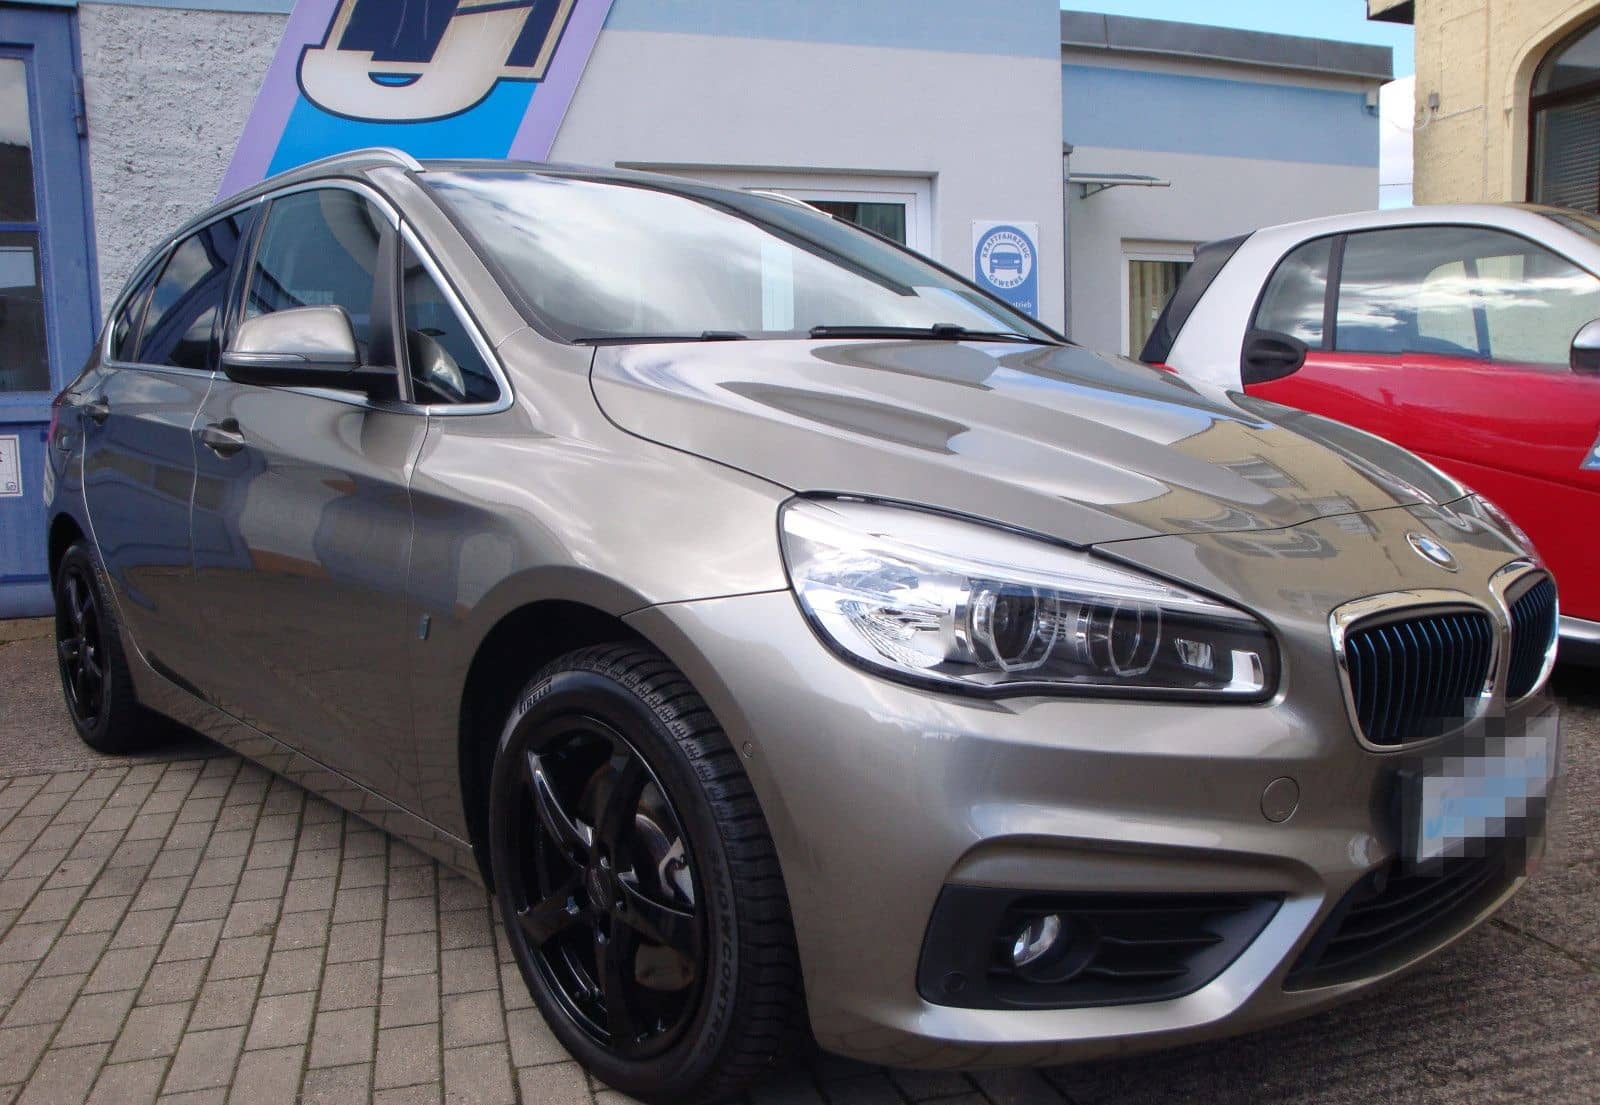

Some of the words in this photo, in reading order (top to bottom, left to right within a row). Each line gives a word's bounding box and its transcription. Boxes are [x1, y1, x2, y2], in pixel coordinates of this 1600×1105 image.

[982, 232, 1030, 259] KRAFTFAHRZEUG
[988, 274, 1023, 288] GEWERBE
[519, 678, 553, 714] PIRELLI
[704, 850, 733, 1056] SNOWCONTRO
